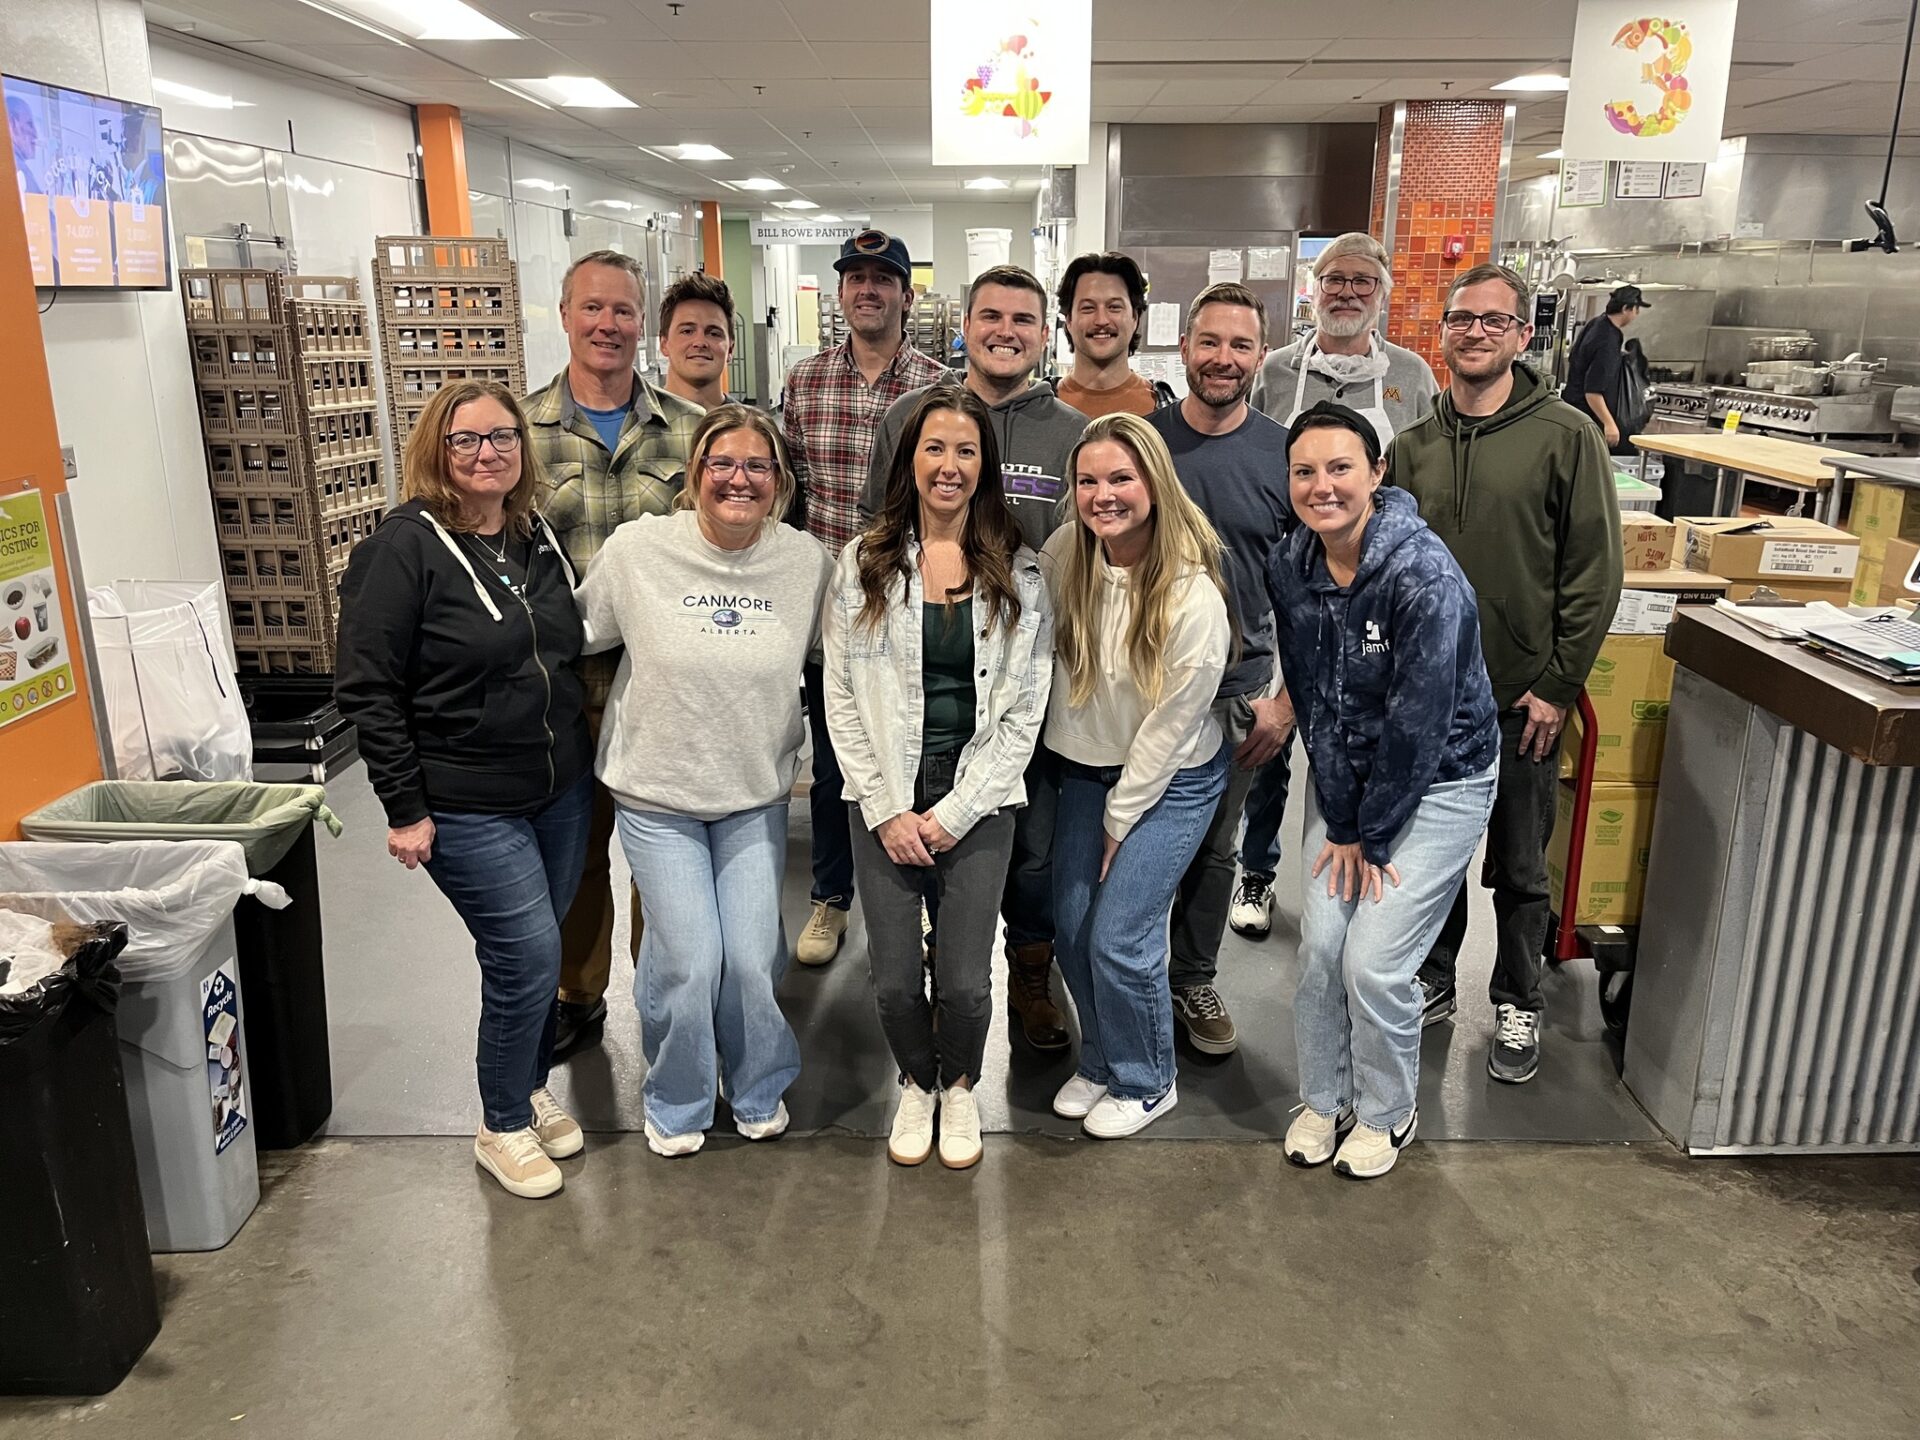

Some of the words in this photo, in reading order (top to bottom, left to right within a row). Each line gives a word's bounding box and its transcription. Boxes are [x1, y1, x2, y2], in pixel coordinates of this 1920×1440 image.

[1604, 17, 1693, 137] 3
[757, 228, 779, 238] BILL
[781, 228, 813, 238] ROWE
[816, 228, 855, 238] PANTRY
[1000, 463, 1042, 475] OTA
[0, 526, 18, 543] ICS
[19, 521, 40, 536] FOR
[0, 536, 38, 556] OSTING
[683, 595, 773, 612] CANMORE
[1682, 592, 1699, 600] AND
[700, 627, 757, 635] ALBERTA
[1361, 639, 1390, 657] jamf
[208, 990, 233, 1018] Recycle
